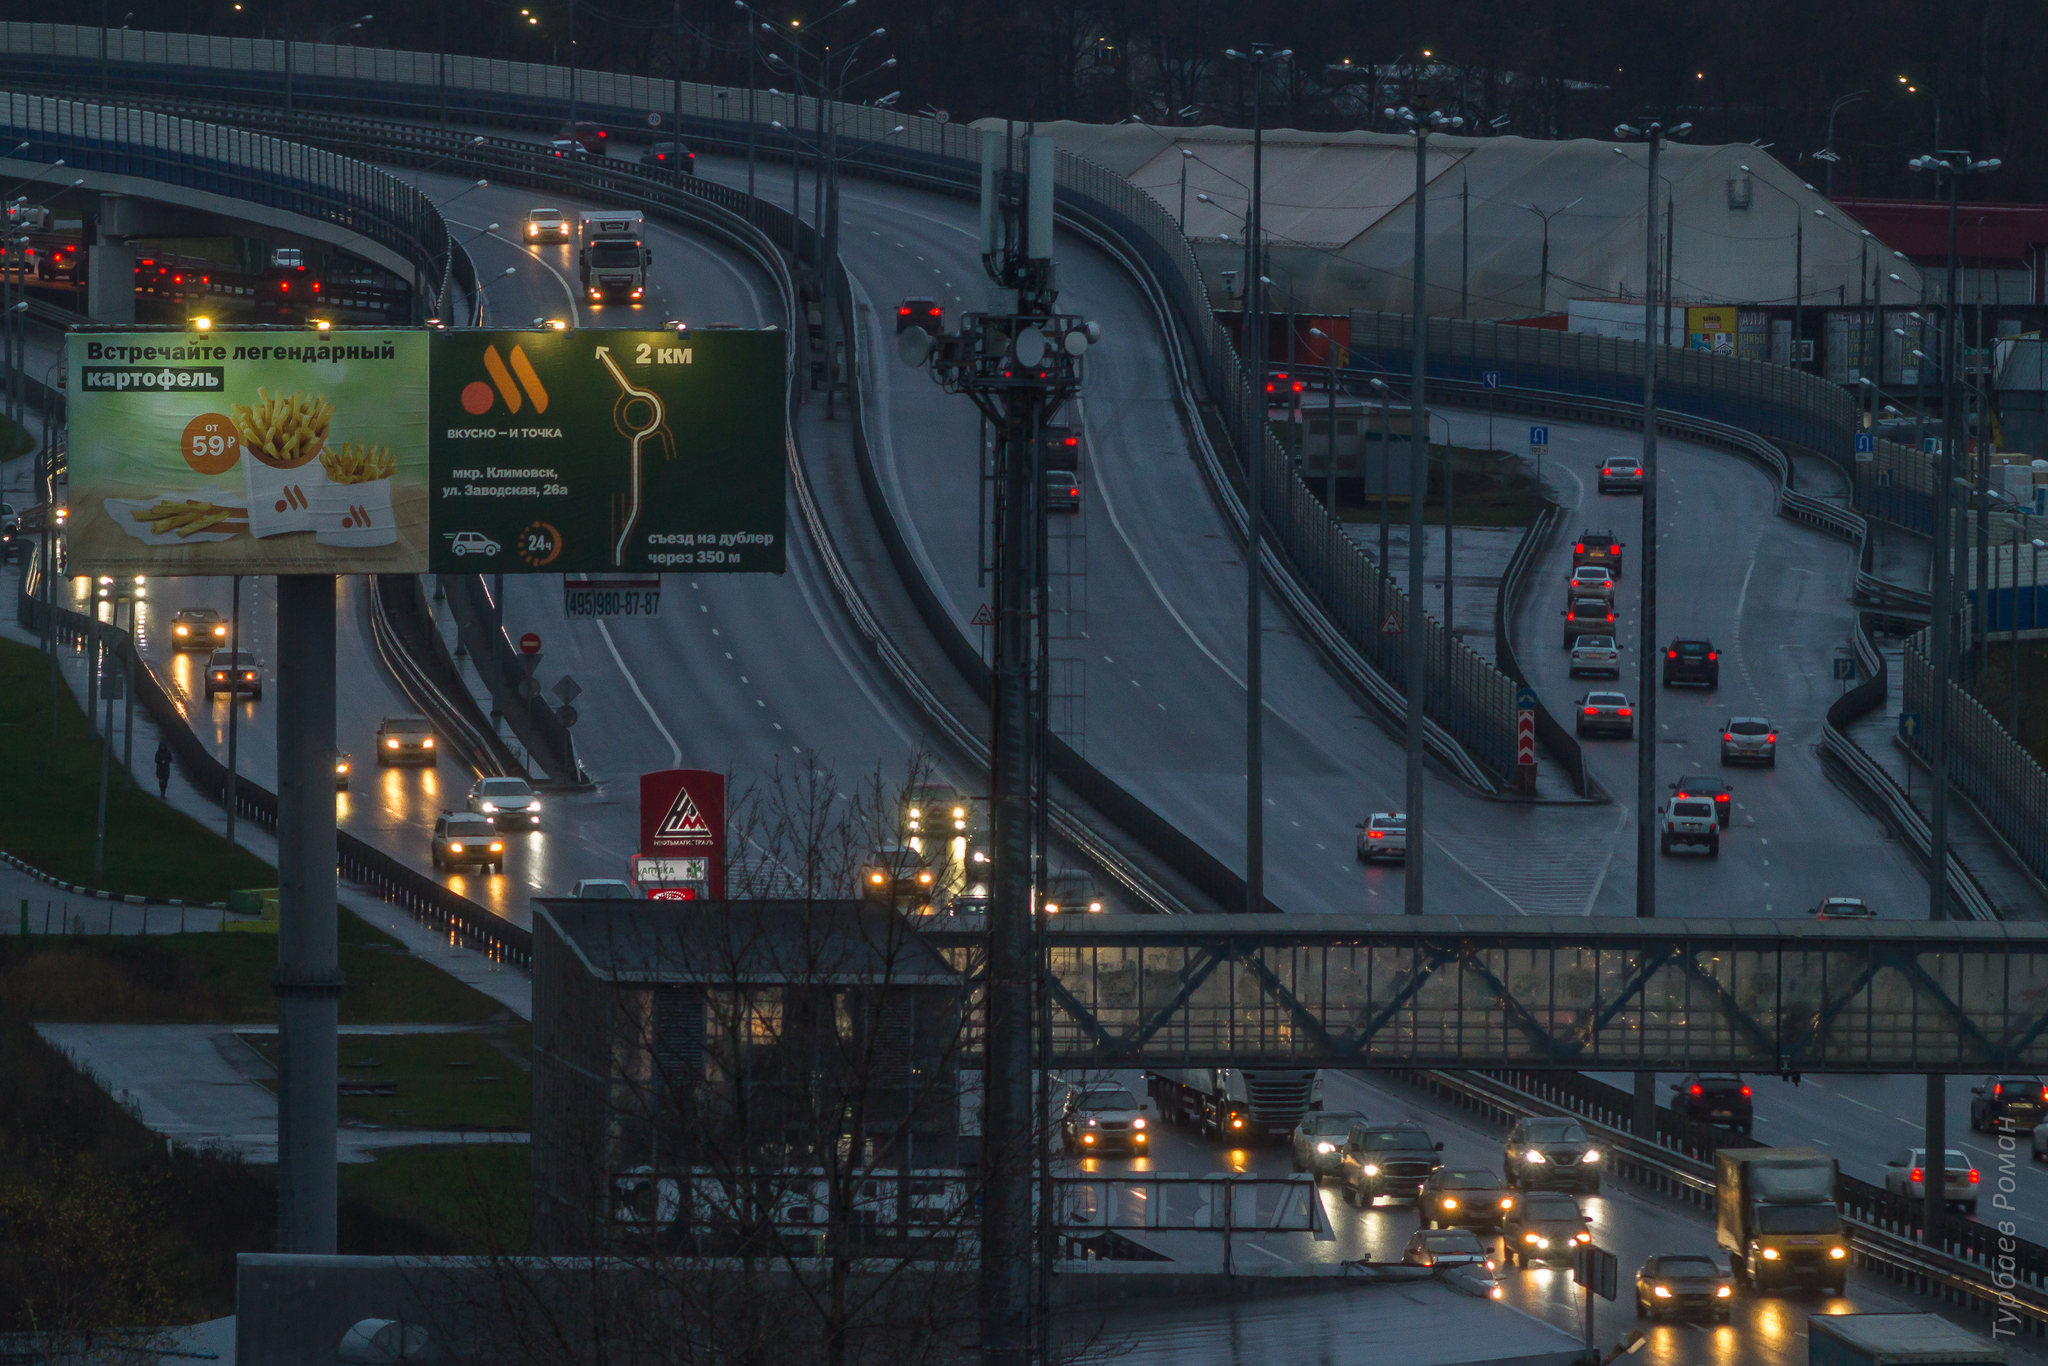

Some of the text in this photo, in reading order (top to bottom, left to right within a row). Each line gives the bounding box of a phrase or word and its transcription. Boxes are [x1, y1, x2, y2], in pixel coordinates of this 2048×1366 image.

[87, 340, 395, 363] Встречайте легендарный
[635, 343, 652, 364] 2
[87, 368, 219, 390] картофель
[205, 424, 219, 432] от
[447, 428, 497, 438] ВКУСНО
[509, 428, 518, 438] И
[521, 428, 562, 438] ТОЧКА
[452, 467, 559, 480] мкр. Климовск,
[442, 484, 568, 498] ул. Заводская, 26а
[648, 532, 774, 547] съезд на дублер
[648, 551, 741, 565] через 350 м
